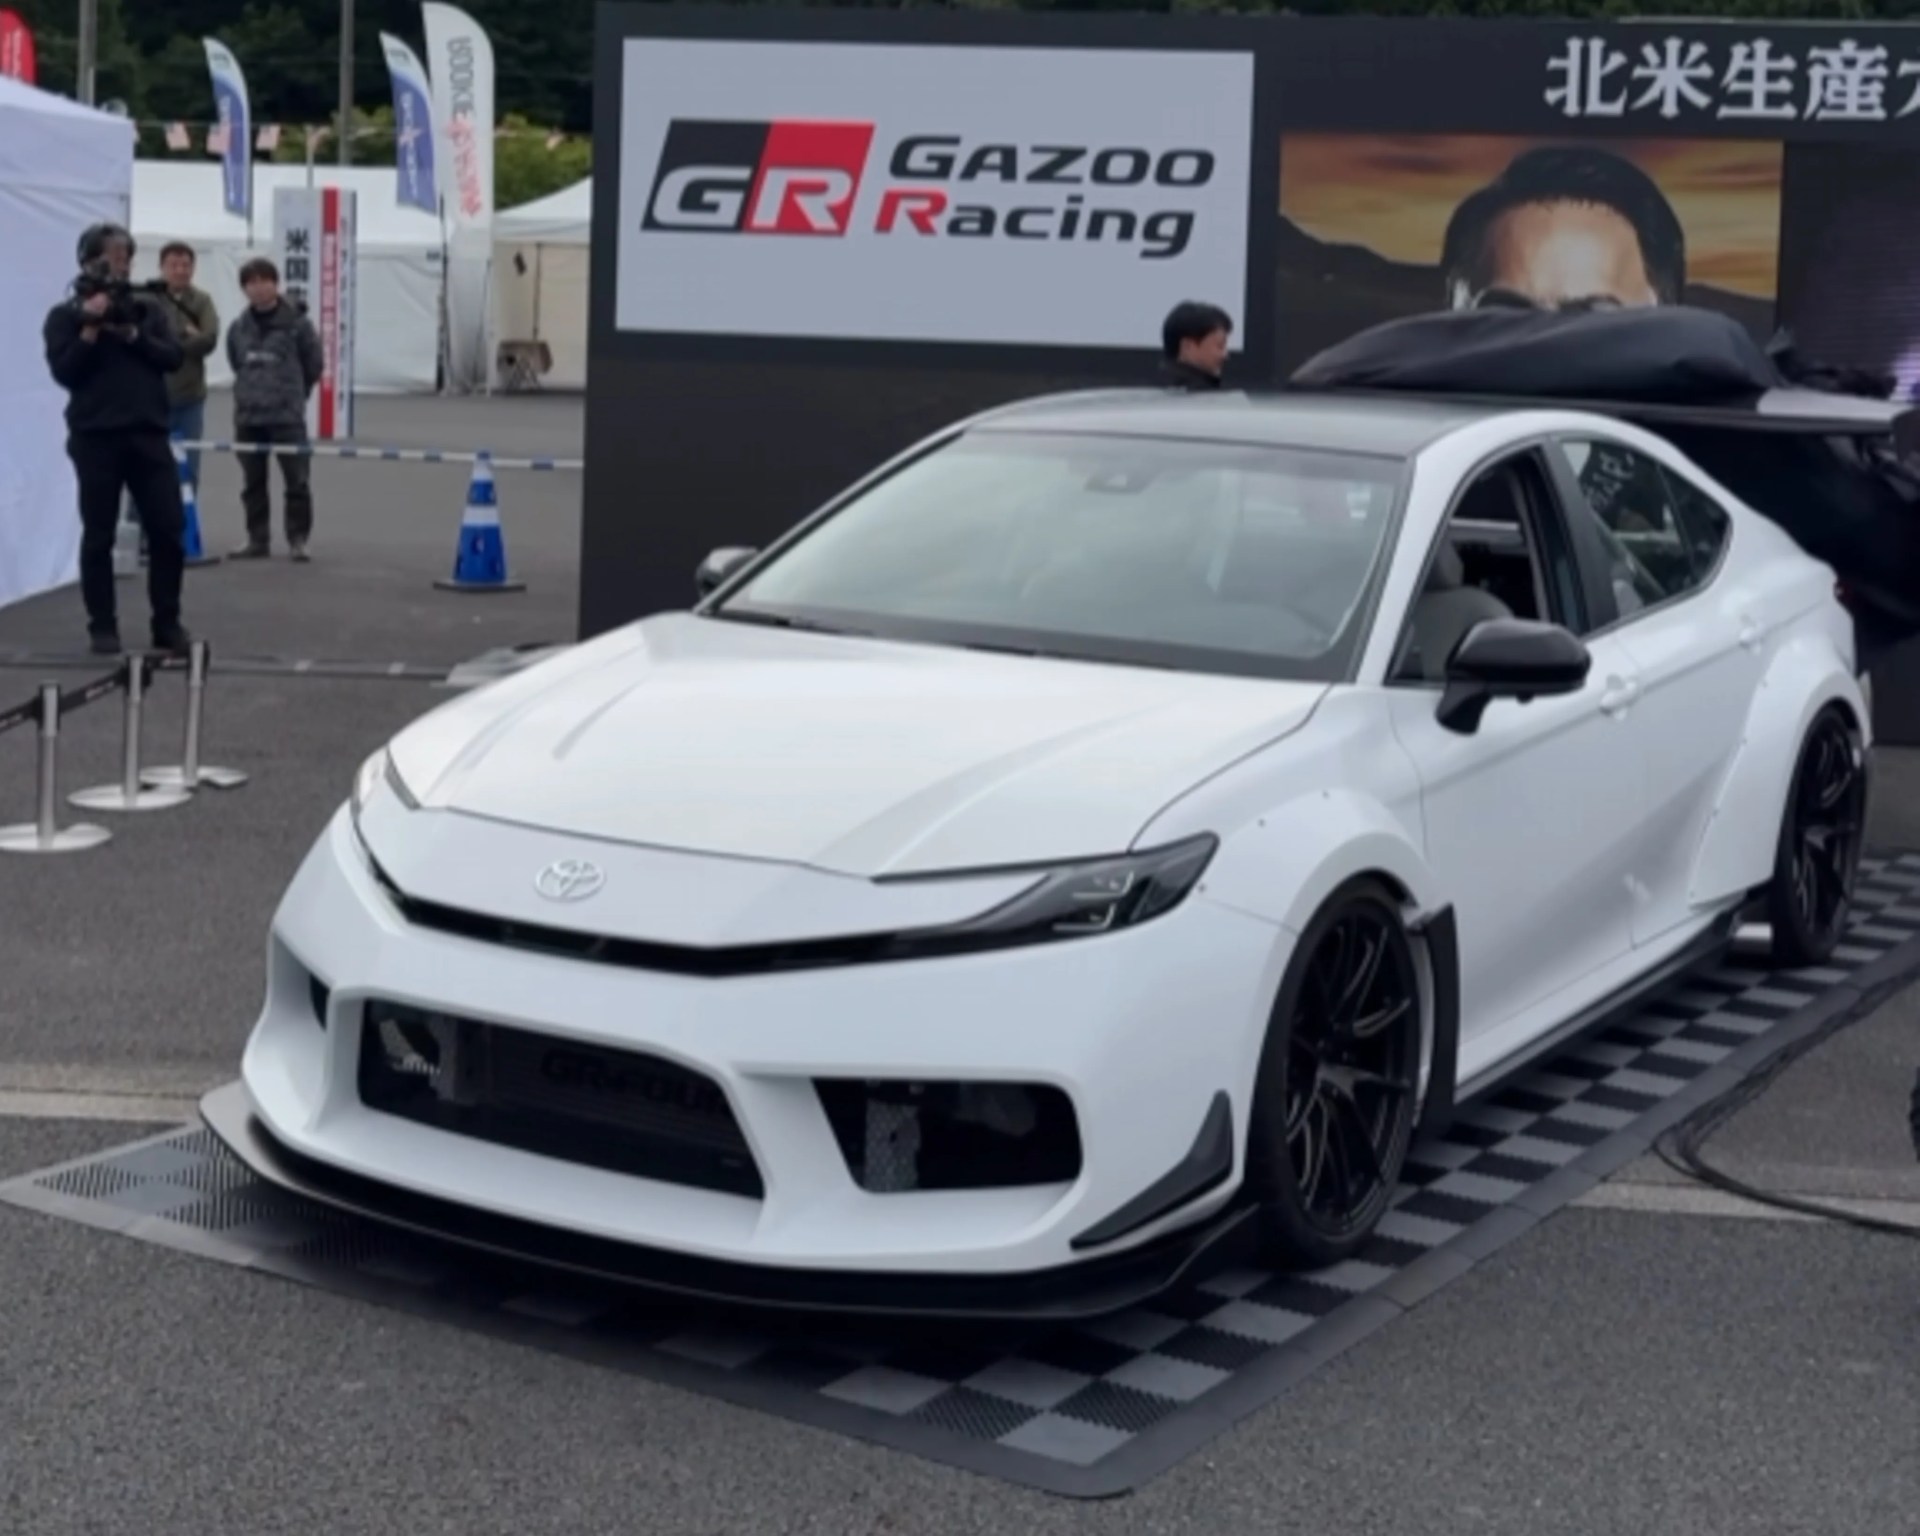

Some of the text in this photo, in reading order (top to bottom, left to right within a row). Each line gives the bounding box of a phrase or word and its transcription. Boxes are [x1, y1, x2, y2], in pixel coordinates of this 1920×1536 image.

[889, 135, 1216, 188] GAZOO
[651, 164, 855, 233] GR
[873, 188, 1197, 260] Racing
